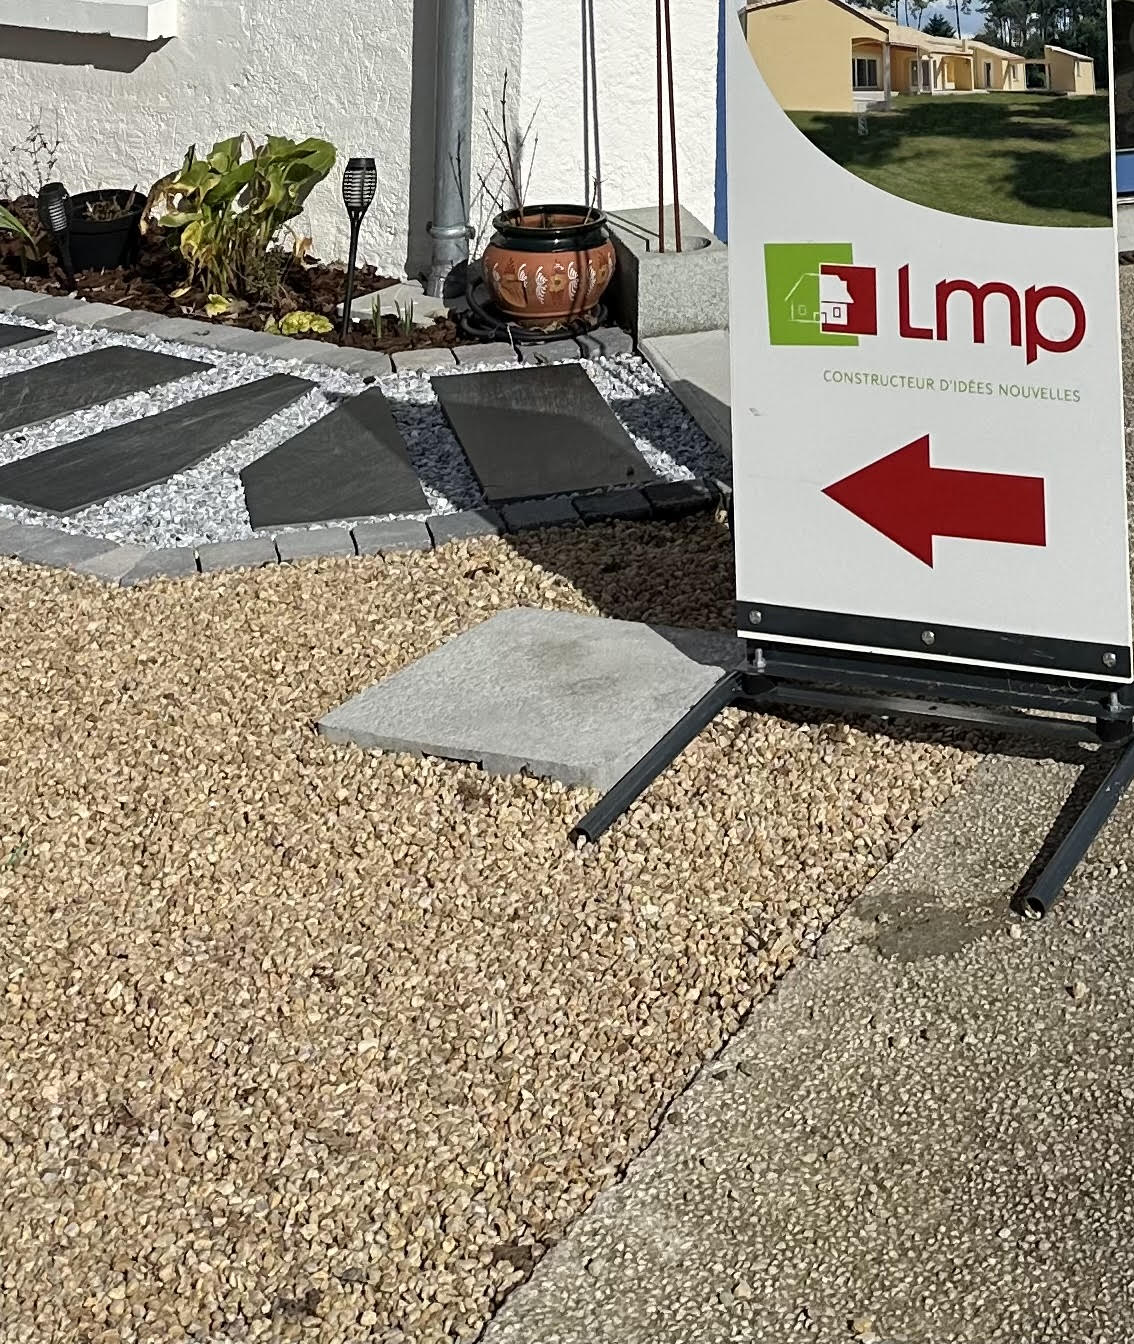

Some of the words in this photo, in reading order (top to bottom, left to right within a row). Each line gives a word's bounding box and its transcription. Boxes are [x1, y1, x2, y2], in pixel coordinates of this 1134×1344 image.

[897, 263, 1087, 366] Lmp
[822, 369, 935, 391] CONSTRUCTEUR
[939, 377, 994, 396] D'IDÉES
[997, 384, 1082, 403] NOUVELLES
